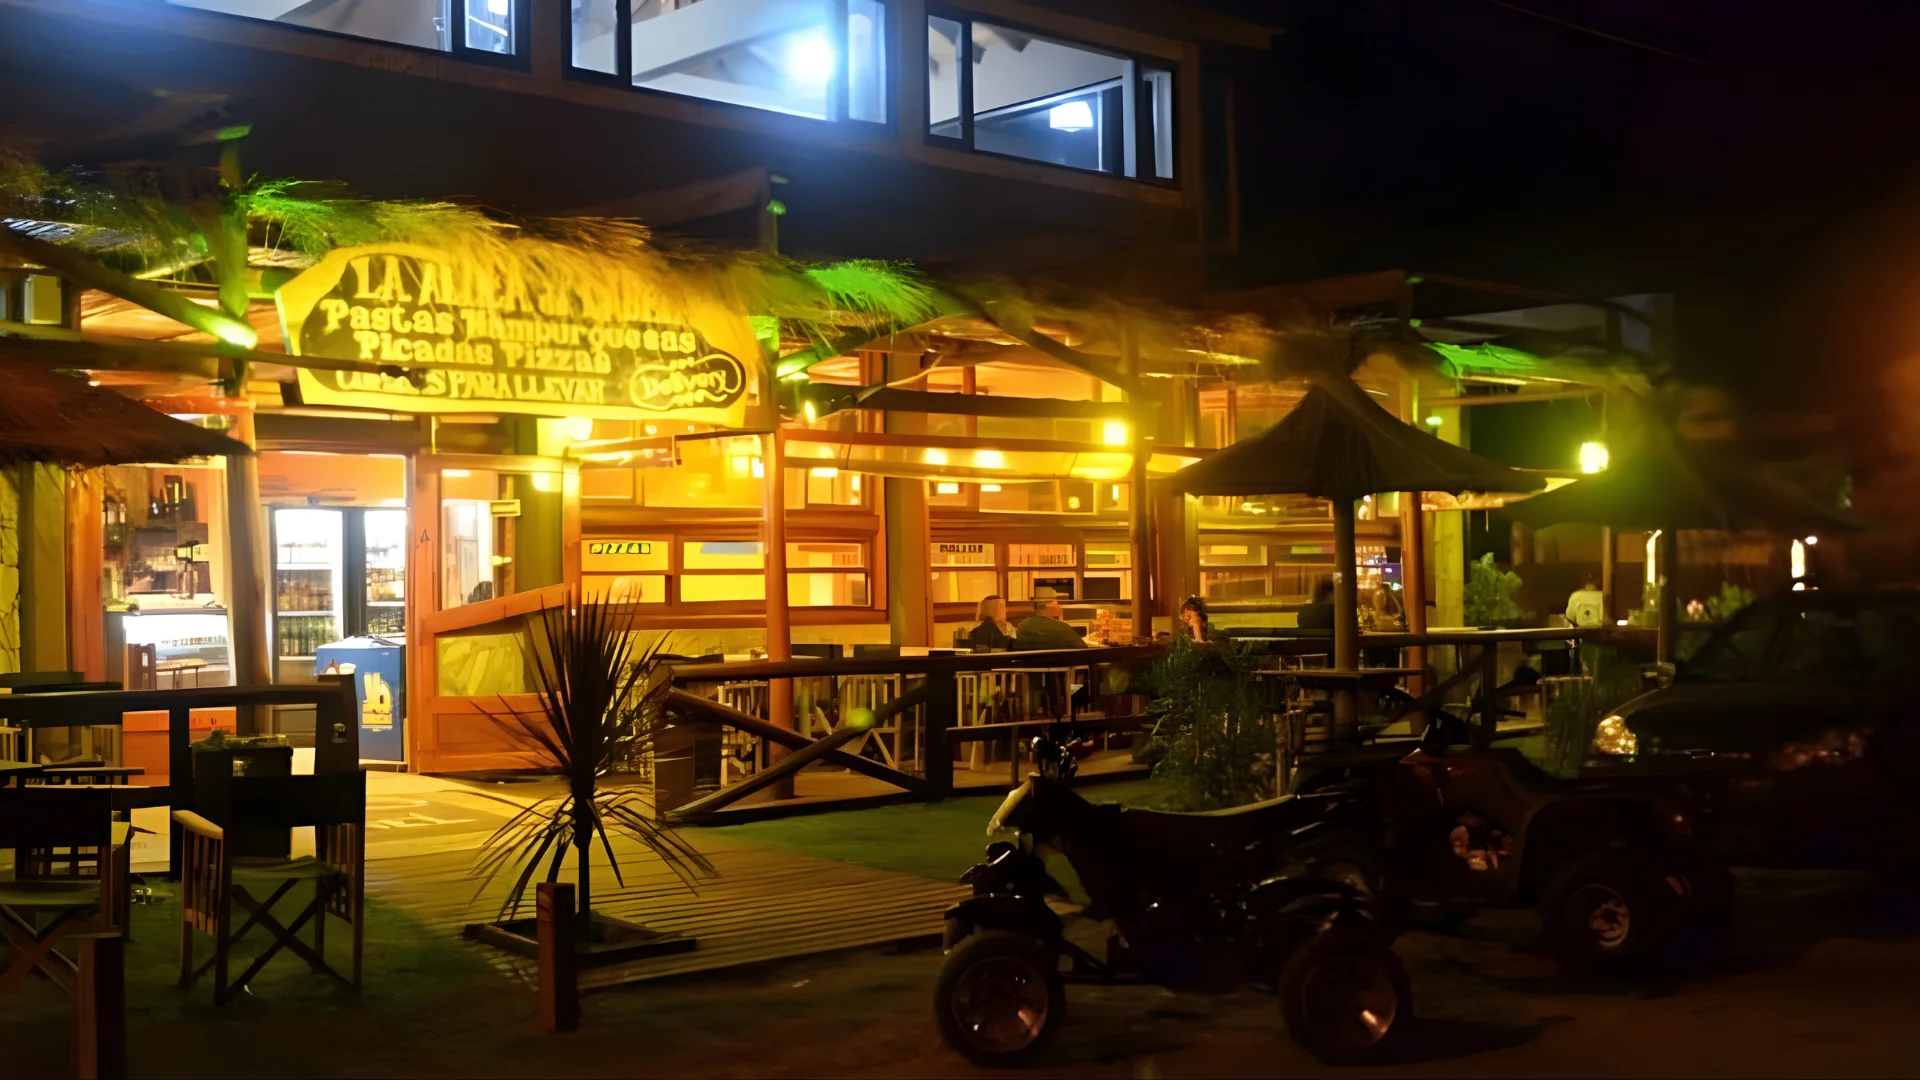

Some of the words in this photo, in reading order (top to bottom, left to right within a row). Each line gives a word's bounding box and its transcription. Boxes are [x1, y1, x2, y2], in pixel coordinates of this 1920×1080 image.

[350, 255, 412, 303] LA
[320, 298, 455, 336] Pastas
[352, 330, 494, 366] Picadas
[501, 343, 612, 374] Pizzas
[449, 370, 513, 399] PARA
